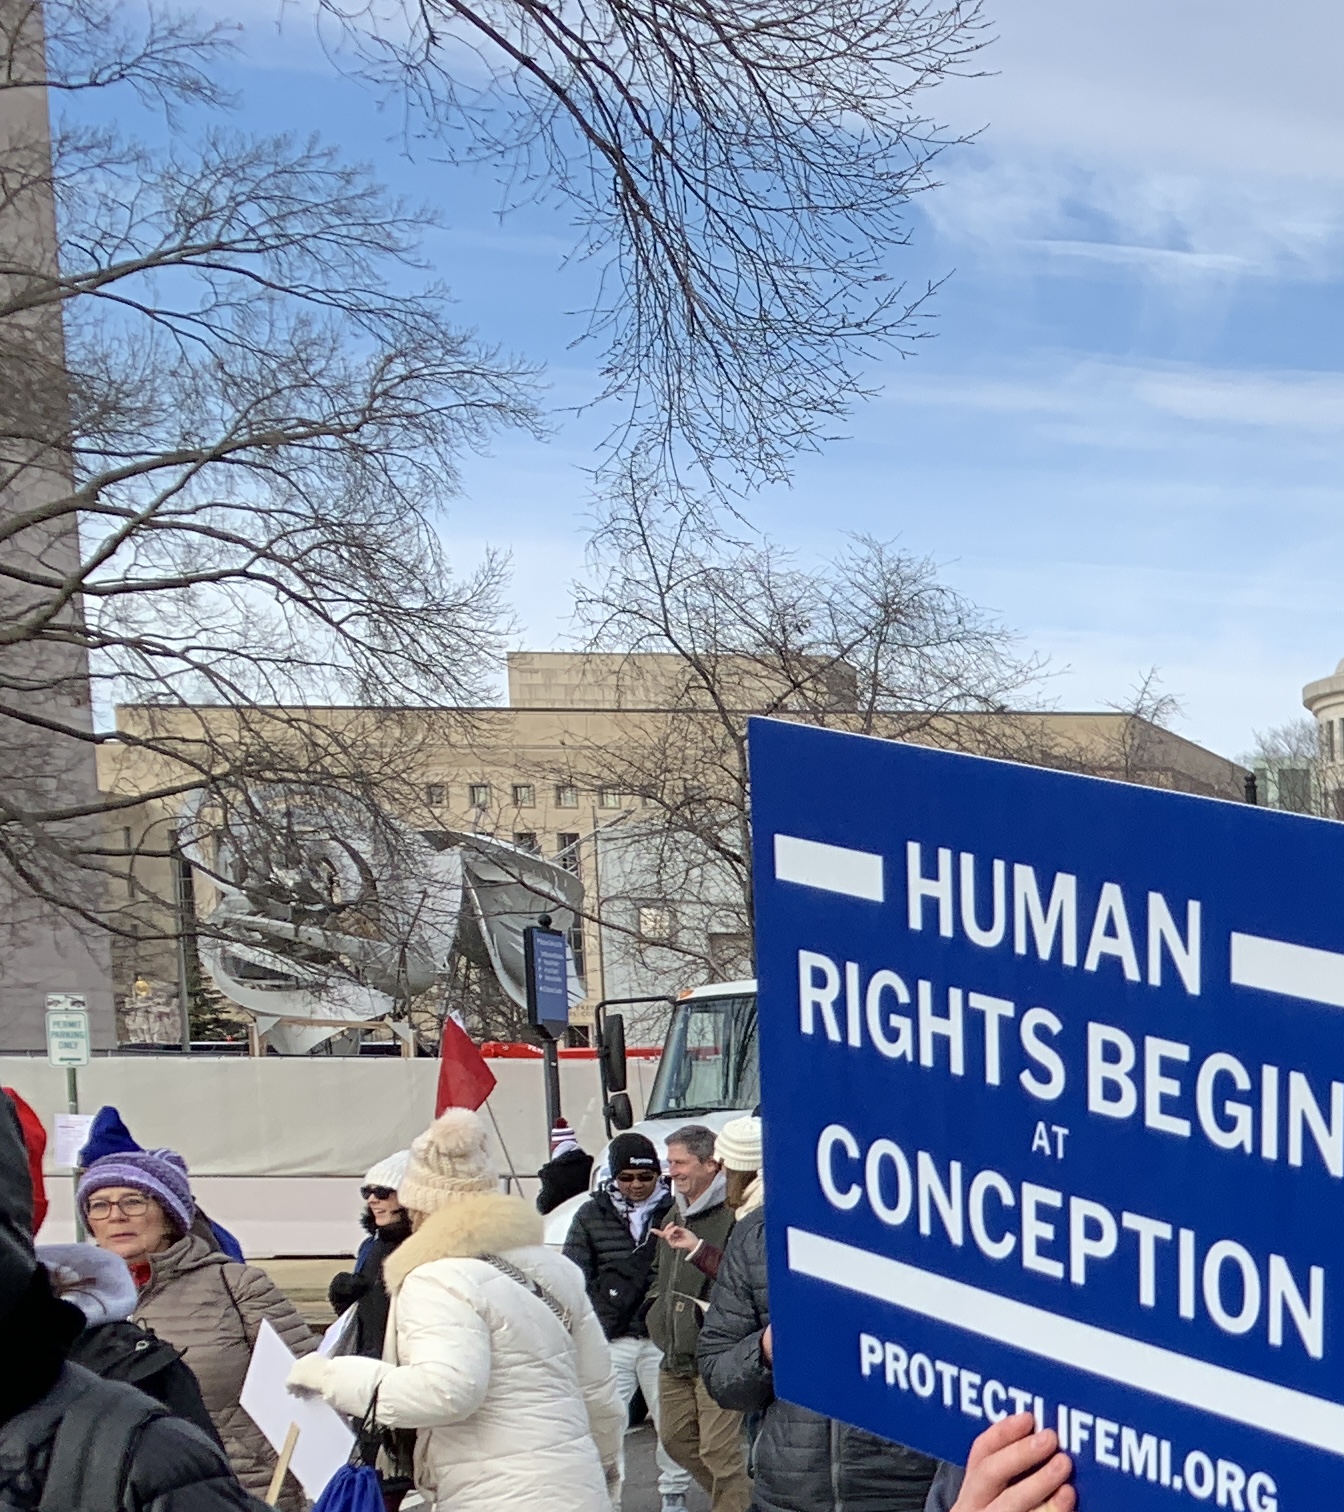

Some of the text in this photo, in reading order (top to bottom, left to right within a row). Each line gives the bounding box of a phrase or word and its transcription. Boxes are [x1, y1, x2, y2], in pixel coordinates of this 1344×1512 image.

[906, 840, 1202, 996] HUMAN
[798, 949, 1344, 1178] RIGHTS BEGIN
[1031, 1120, 1070, 1159] AT
[816, 1124, 1325, 1360] CONCEPTION
